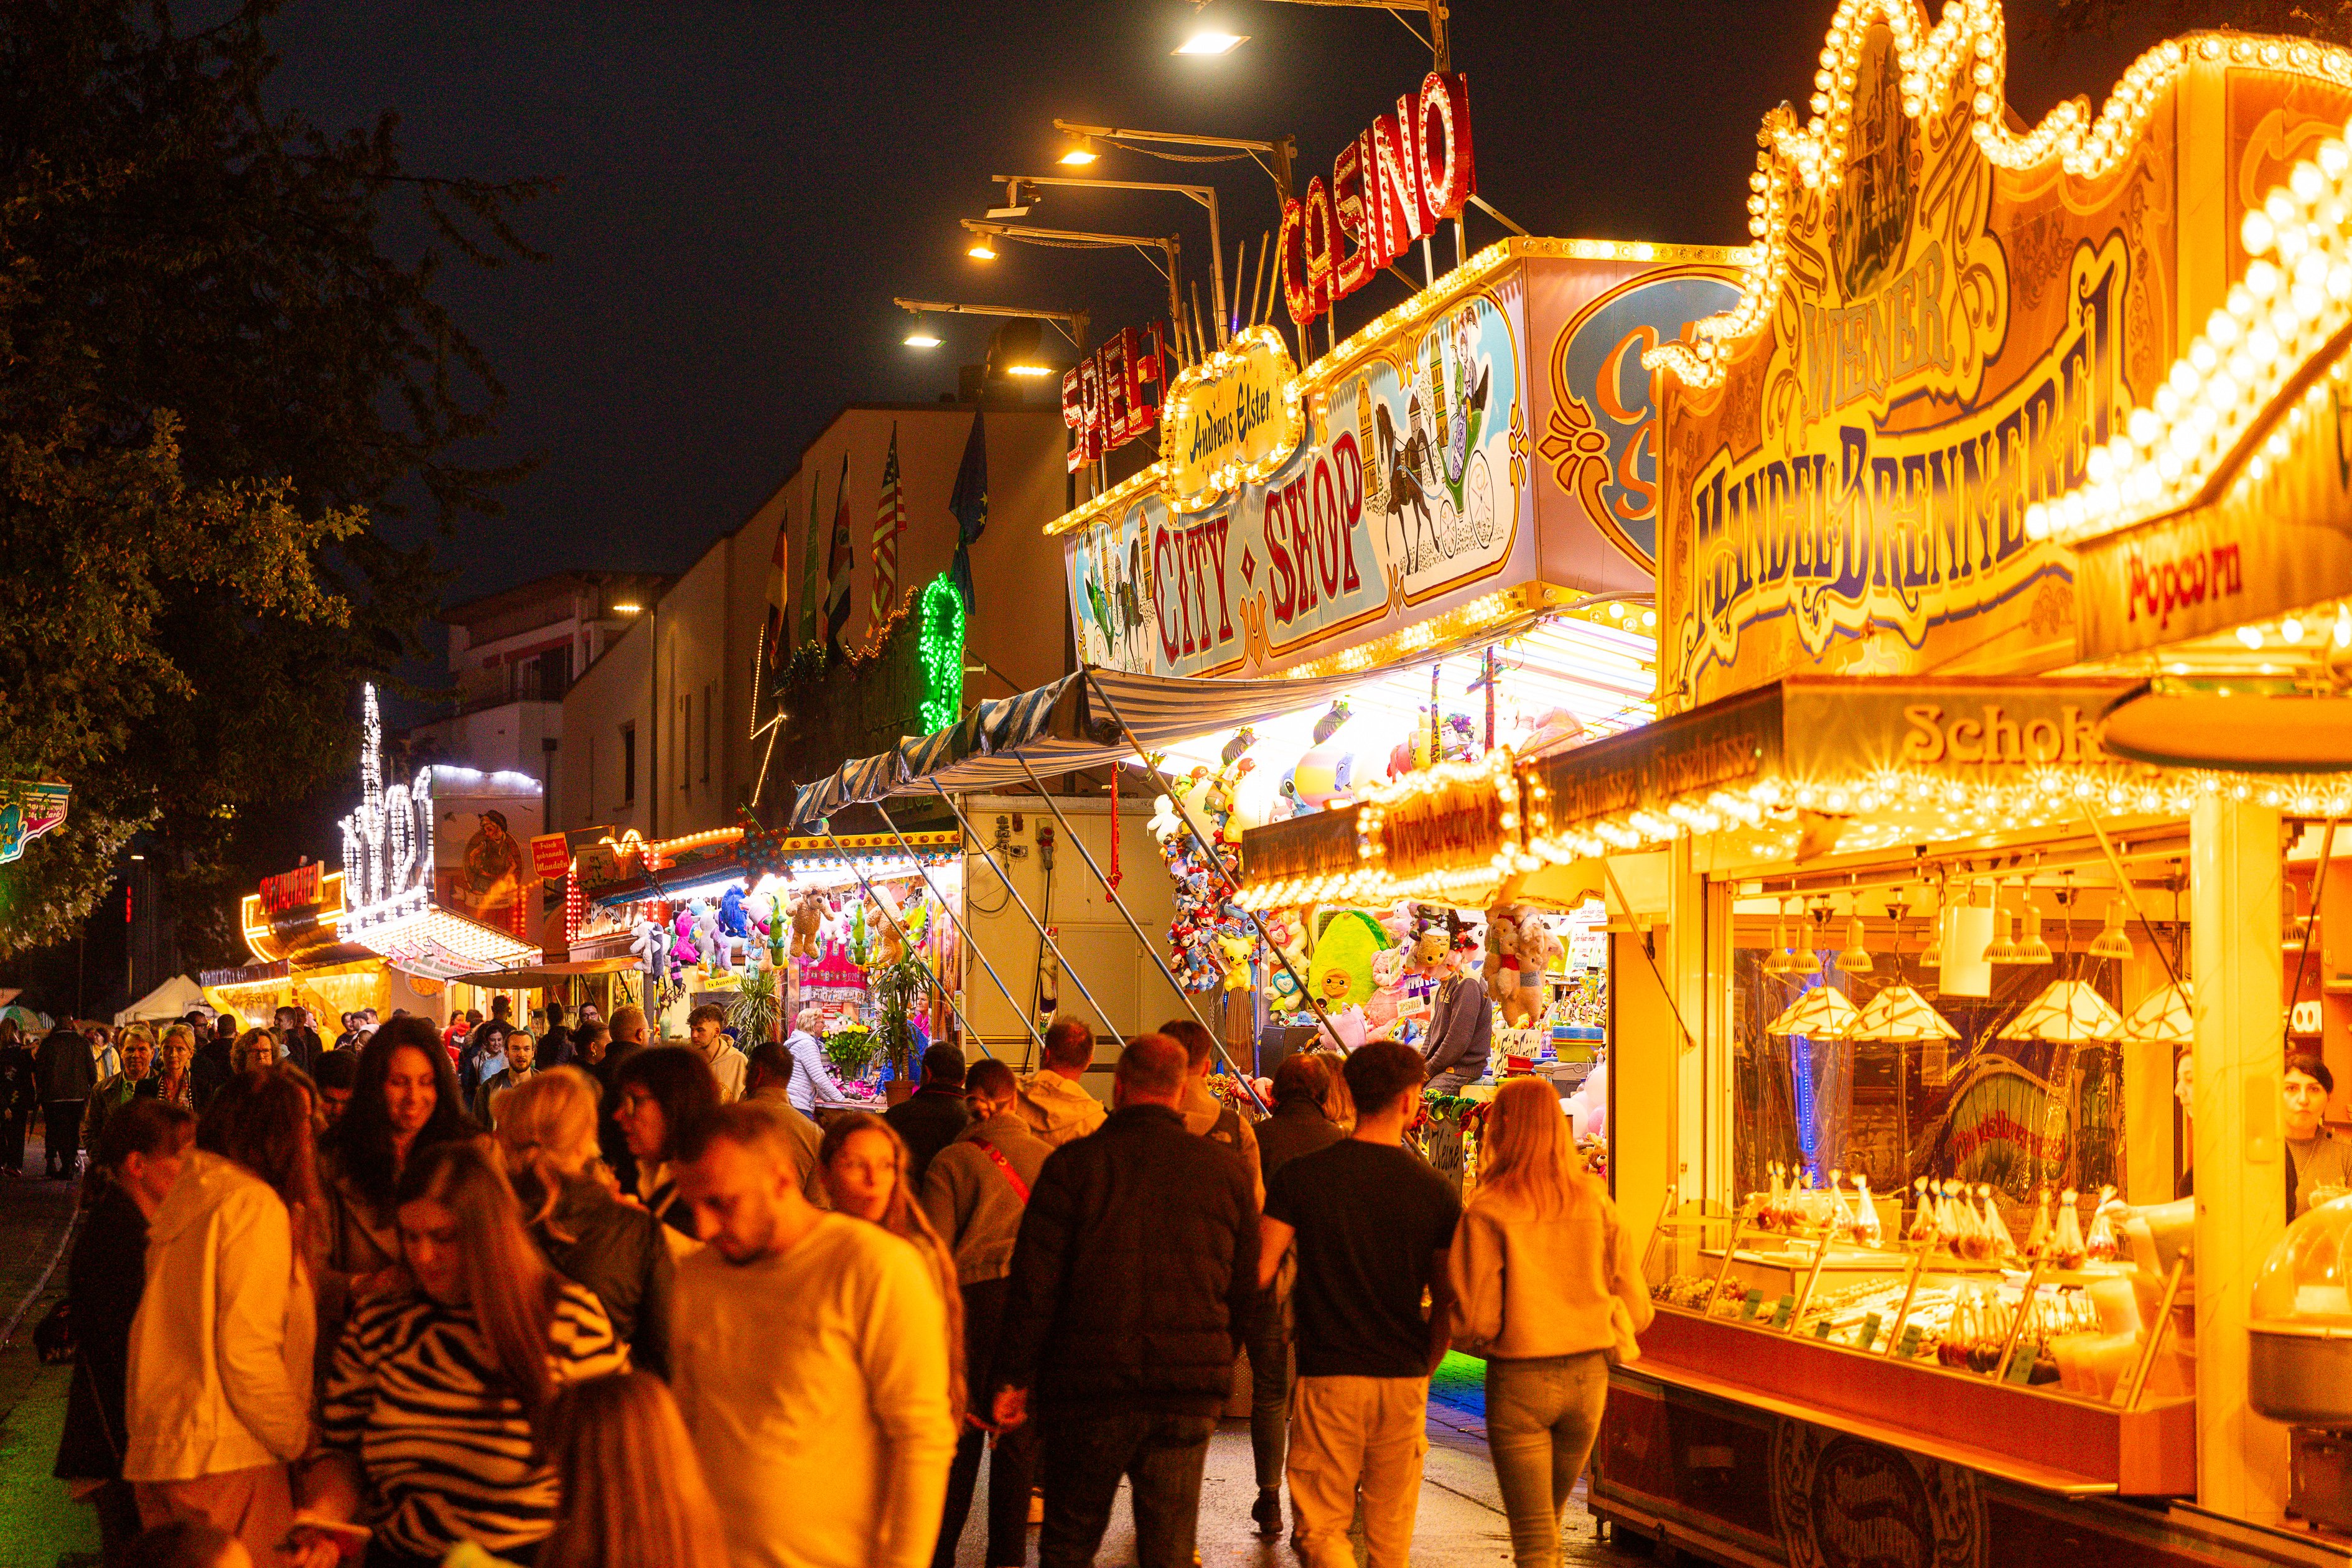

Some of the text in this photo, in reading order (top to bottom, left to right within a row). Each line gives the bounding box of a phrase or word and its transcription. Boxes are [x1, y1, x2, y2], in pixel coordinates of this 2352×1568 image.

[1282, 72, 1467, 324] CASINO
[1803, 240, 1954, 424] WIENER
[1189, 381, 1270, 464] Andreas Elster
[1153, 431, 1364, 667] CITY SHOP
[2129, 543, 2242, 622] Popcorn
[1902, 704, 2125, 765] Schok
[536, 858, 569, 872] Mandeln
[539, 840, 558, 850] Frisch
[716, 976, 738, 987] Auswahl
[1399, 999, 1421, 1013] 2500
[1432, 1127, 1460, 1170] Keine
